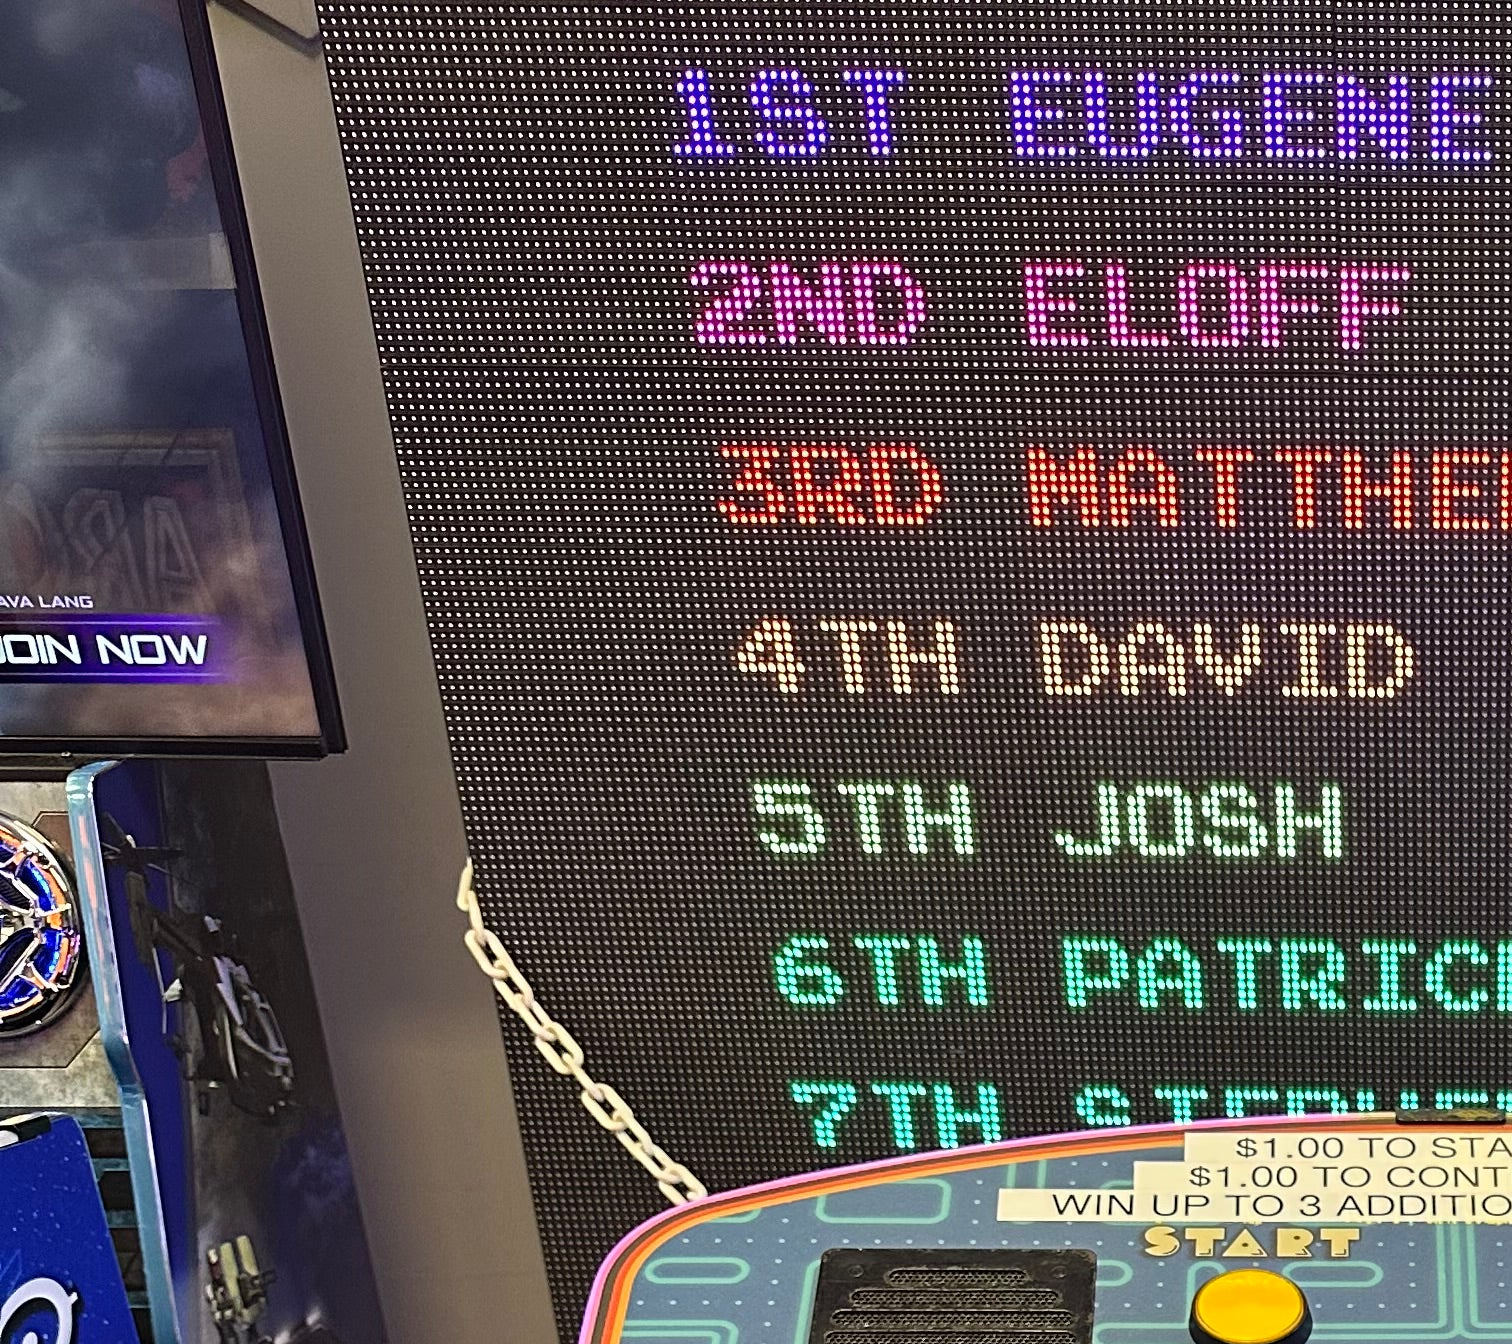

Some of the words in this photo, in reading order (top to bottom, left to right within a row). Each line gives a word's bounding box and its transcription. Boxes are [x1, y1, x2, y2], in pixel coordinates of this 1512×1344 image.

[674, 68, 908, 158] 1ST
[1010, 70, 1493, 162] EUGENE
[691, 260, 928, 347] 2ND
[1023, 260, 1411, 348] ELOFF
[717, 442, 943, 527] 3RD
[38, 595, 94, 608] LANG
[95, 634, 207, 665] NOW
[735, 617, 961, 697] 4TH
[1036, 620, 1416, 699] DAVID
[749, 780, 977, 858] 5TH
[1053, 781, 1346, 861] JOSH
[773, 935, 989, 1007] 6TH
[791, 1081, 1000, 1149] 7TH
[1236, 1136, 1344, 1159] $1.00
[1358, 1137, 1417, 1158] TO
[1052, 1193, 1135, 1216] WIN
[1153, 1193, 1211, 1216] UP
[1224, 1194, 1284, 1216] TO
[1300, 1194, 1321, 1216] 3
[1188, 1165, 1297, 1188] $1.00
[1313, 1166, 1371, 1187] TO
[1143, 1226, 1361, 1258] START
